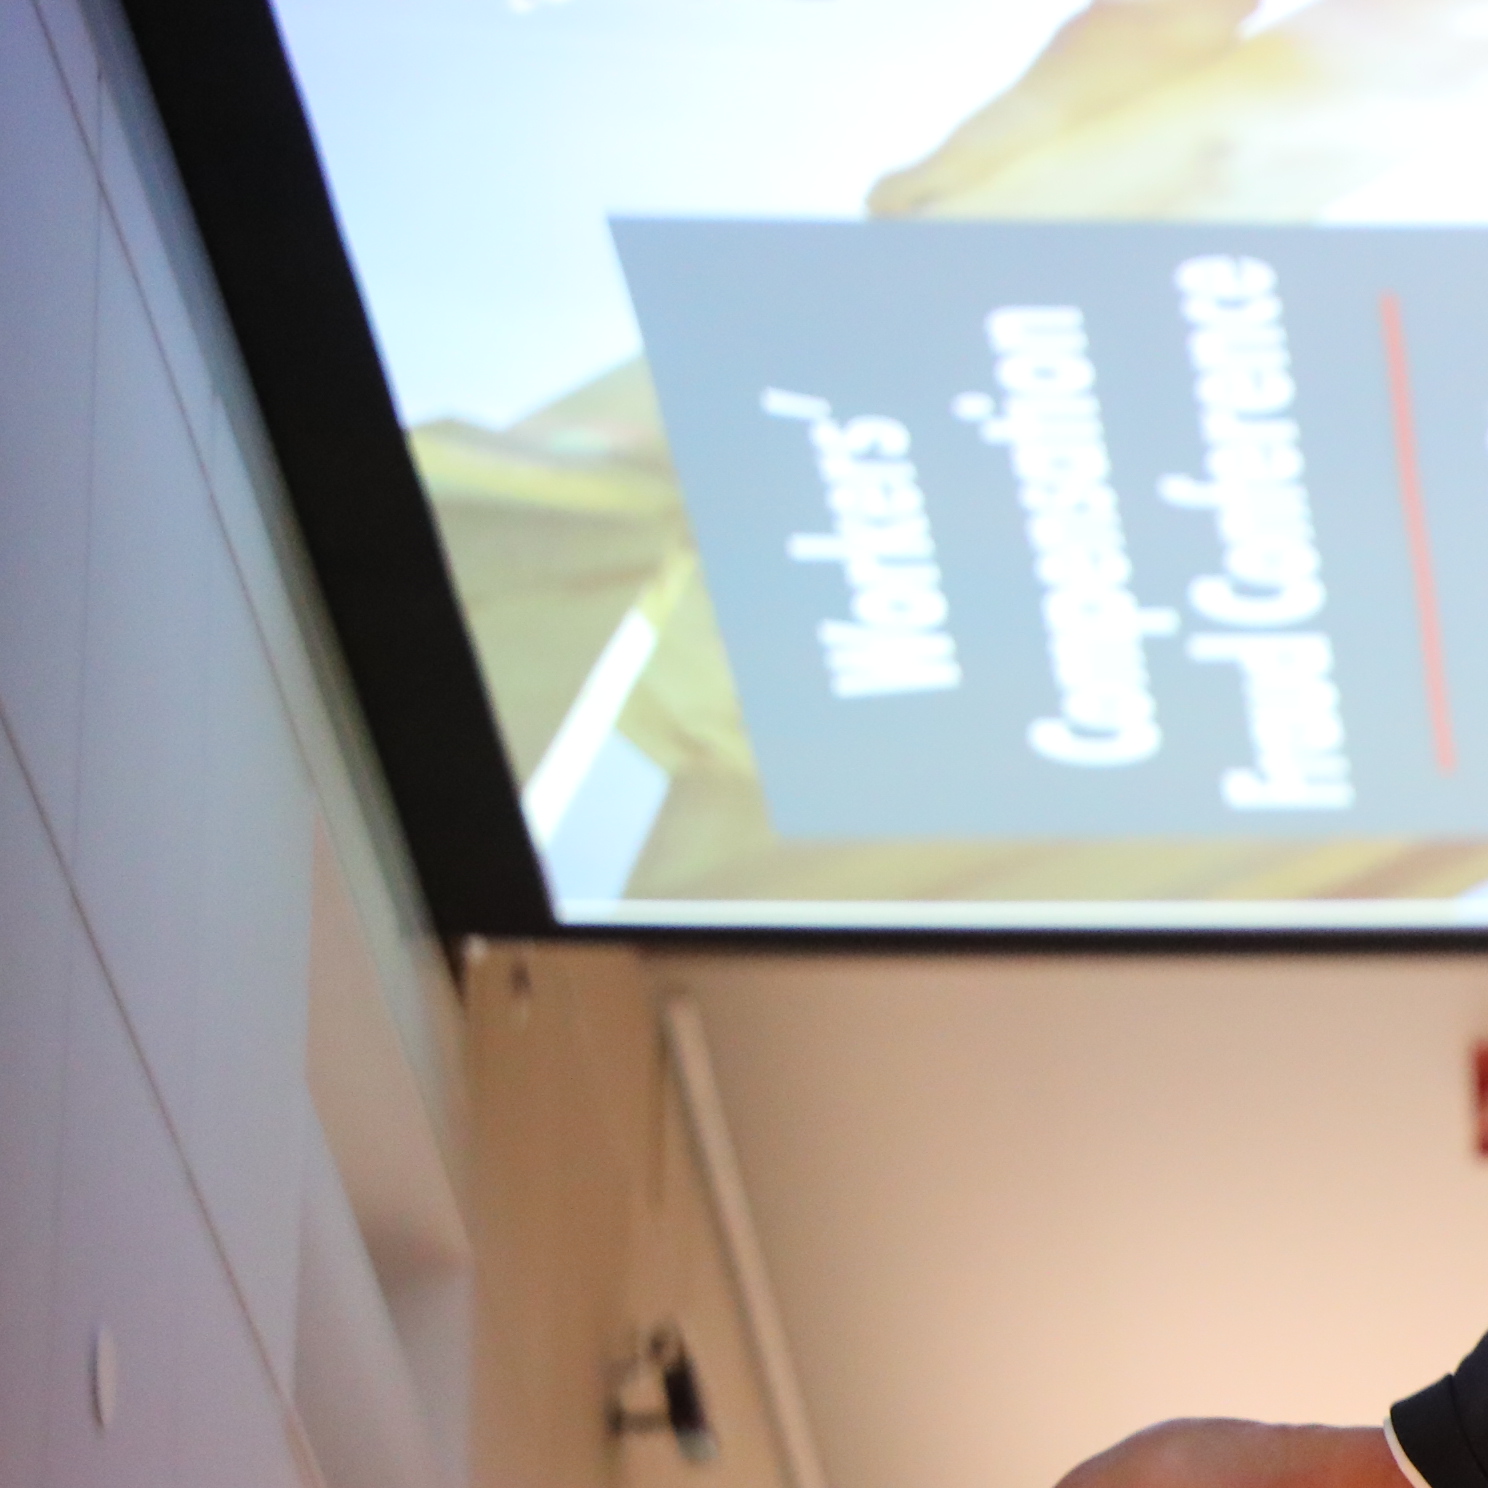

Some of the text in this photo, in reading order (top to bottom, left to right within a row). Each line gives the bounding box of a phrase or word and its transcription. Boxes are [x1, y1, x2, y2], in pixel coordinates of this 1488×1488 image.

[950, 305, 1178, 764] Compensation
[1157, 255, 1351, 806] Fraud Conference
